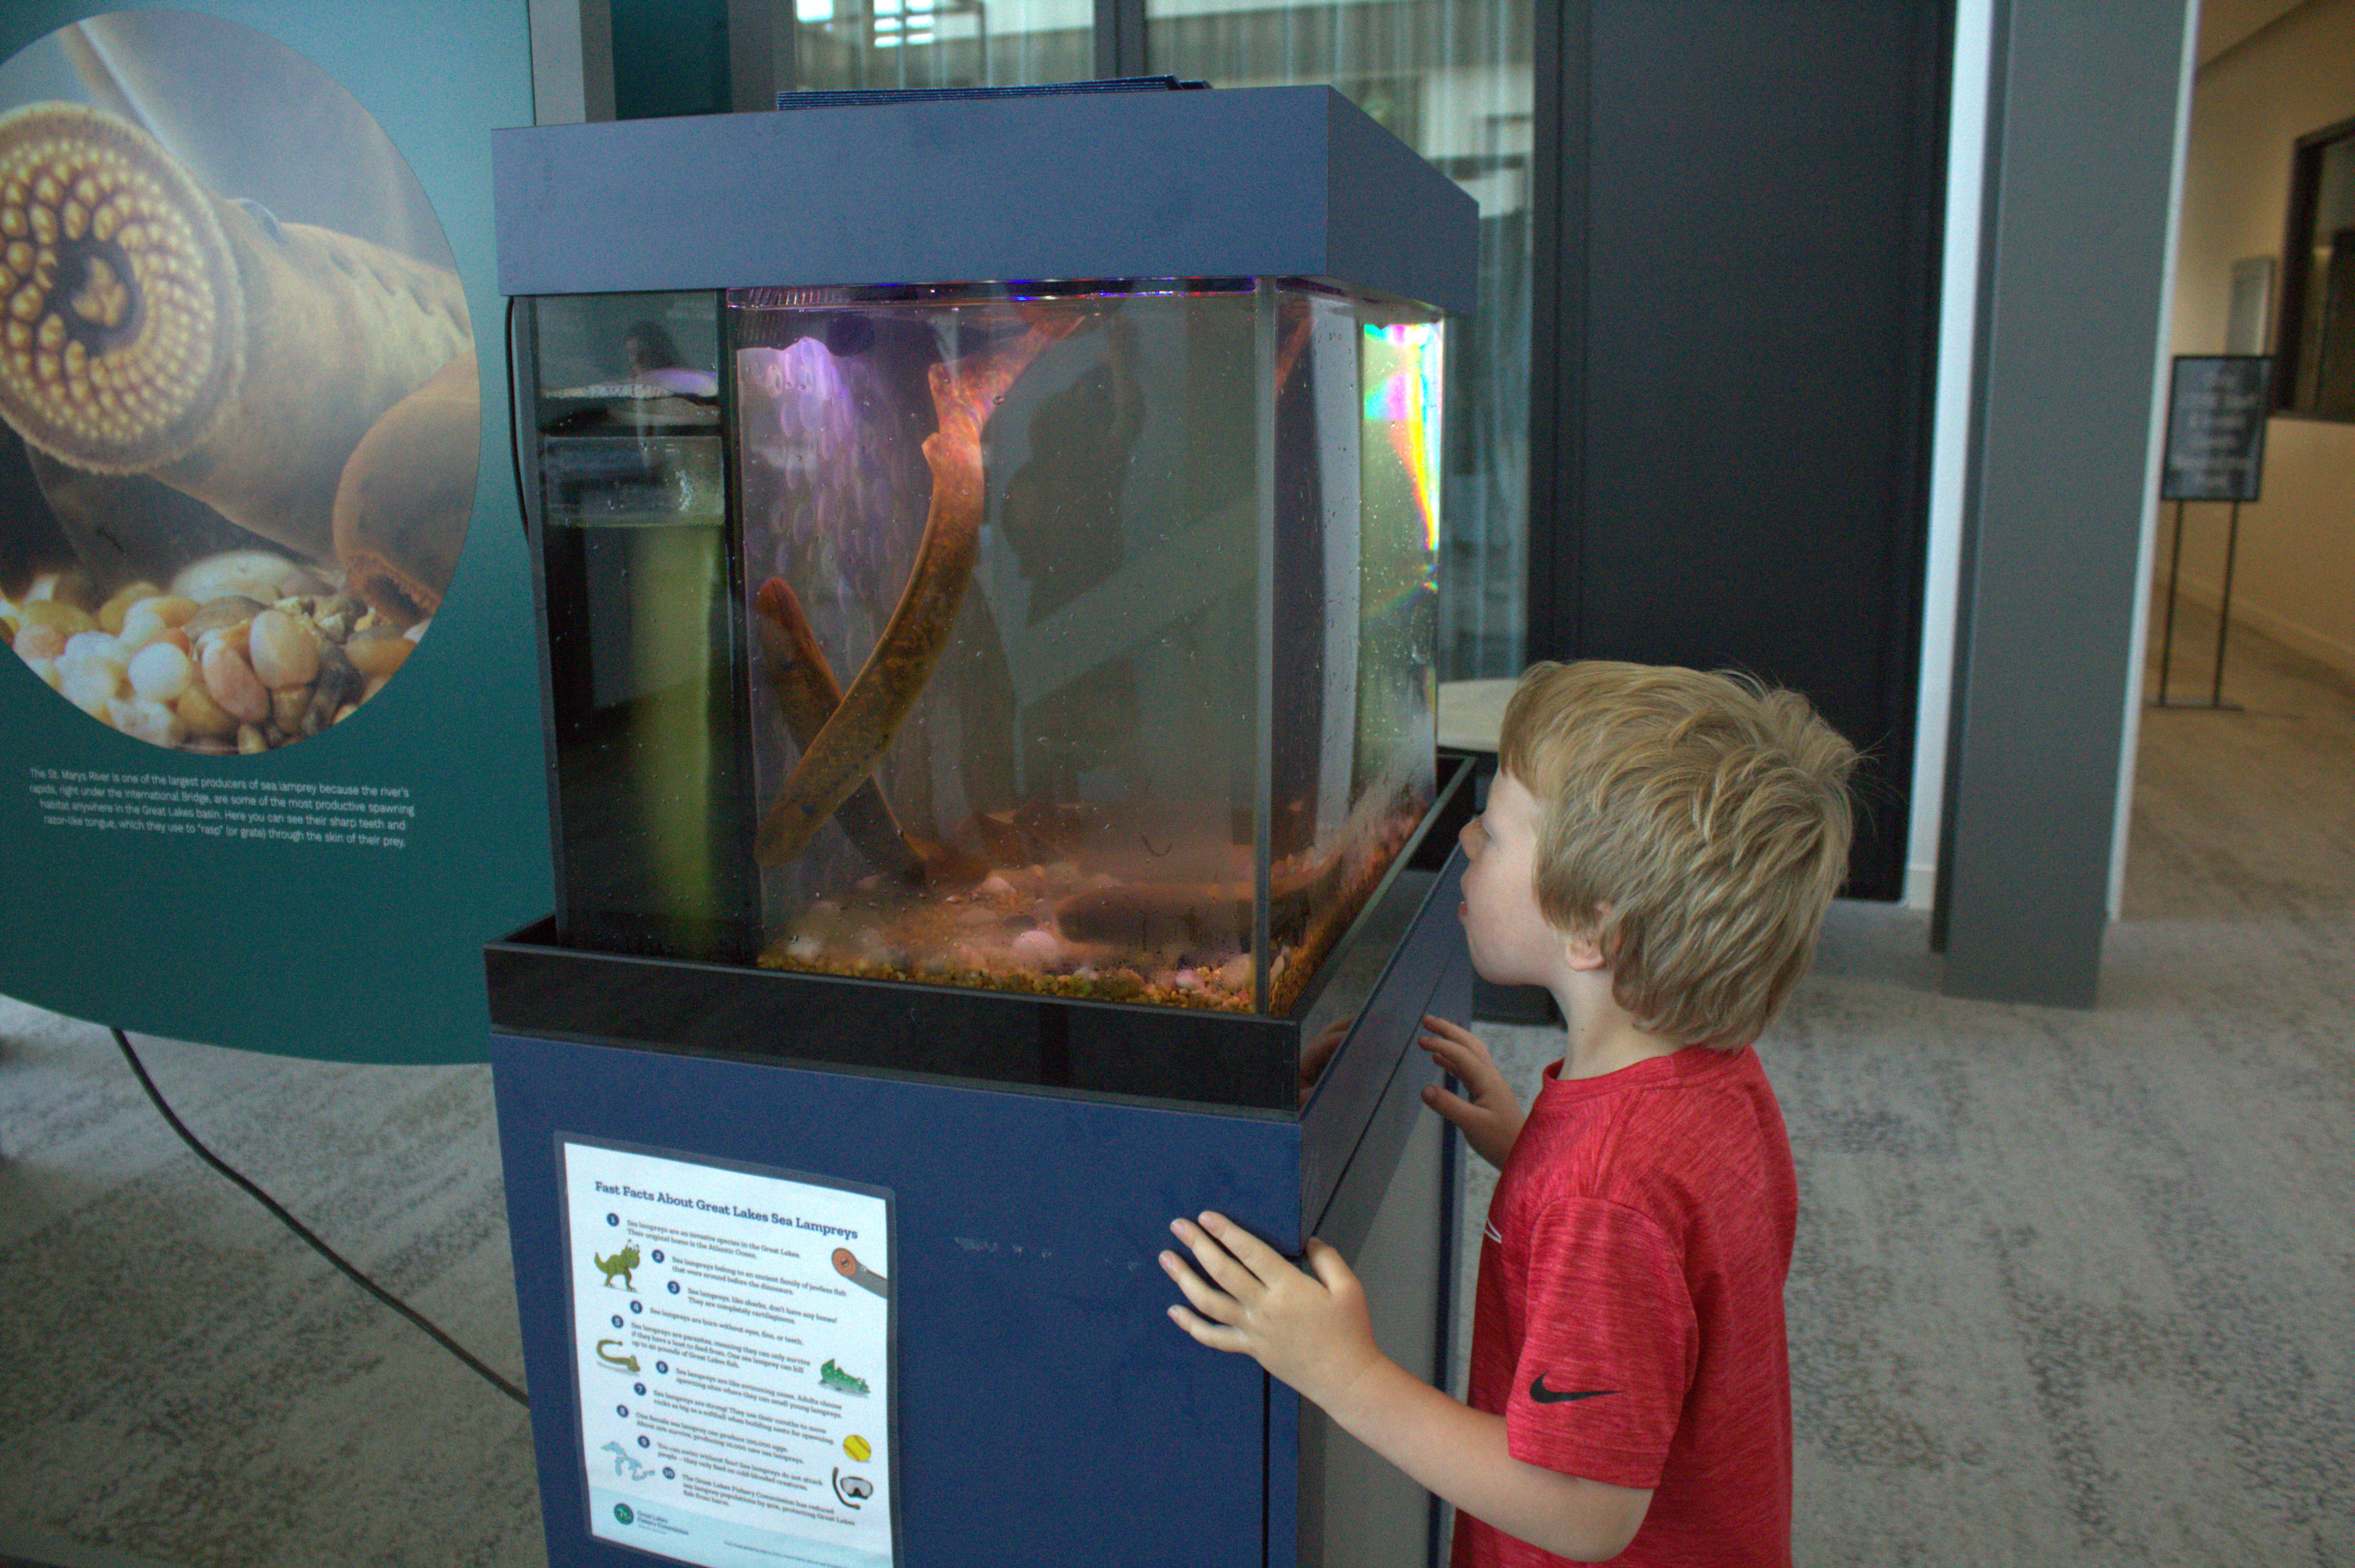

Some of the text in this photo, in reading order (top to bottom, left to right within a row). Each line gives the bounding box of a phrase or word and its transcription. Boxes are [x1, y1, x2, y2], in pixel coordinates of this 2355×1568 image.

[29, 768, 46, 778] The
[48, 769, 59, 779] St.
[61, 770, 86, 783] Marys
[88, 771, 109, 782] River
[112, 773, 120, 782] is
[140, 773, 149, 784] of
[152, 774, 166, 784] the
[168, 775, 198, 788] largest
[201, 777, 246, 789] producers
[248, 779, 258, 789] of
[260, 782, 276, 791] sea
[279, 781, 316, 795] lamprey
[319, 783, 359, 795] because
[362, 784, 377, 795] the
[39, 798, 406, 830] habitat anywhere in the Great Lakes basin. Here you can see their sharp teeth and
[59, 785, 78, 797] right
[80, 786, 105, 796] under
[108, 787, 121, 797] the
[124, 788, 178, 801] International
[213, 795, 228, 804] are
[230, 796, 256, 805] some
[258, 795, 268, 806] of
[270, 795, 285, 807] the
[288, 798, 312, 808] most
[315, 799, 365, 812] productive
[368, 803, 415, 818] spawning
[119, 818, 144, 830] which
[146, 820, 166, 833] they
[167, 824, 183, 832] use
[186, 823, 195, 833] to
[225, 825, 237, 837] (or
[240, 827, 266, 840] grate)
[268, 828, 304, 842] through
[306, 830, 322, 841] the
[325, 831, 343, 842] skin
[346, 832, 355, 843] of
[358, 833, 380, 845] their
[383, 838, 406, 850] prey.
[594, 1180, 857, 1241] Fast Facts About Great Lakes Sea Lampreys
[626, 1219, 638, 1227] Sea
[638, 1221, 668, 1234] lampreys
[689, 1230, 716, 1242] invasive
[717, 1238, 740, 1246] species
[760, 1244, 779, 1253] Great
[780, 1248, 800, 1258] Lakes.
[626, 1228, 644, 1237] Their
[645, 1232, 670, 1242] original
[671, 1236, 688, 1245] home
[708, 1243, 733, 1253] Atlantic
[734, 1248, 757, 1258] Ocean.
